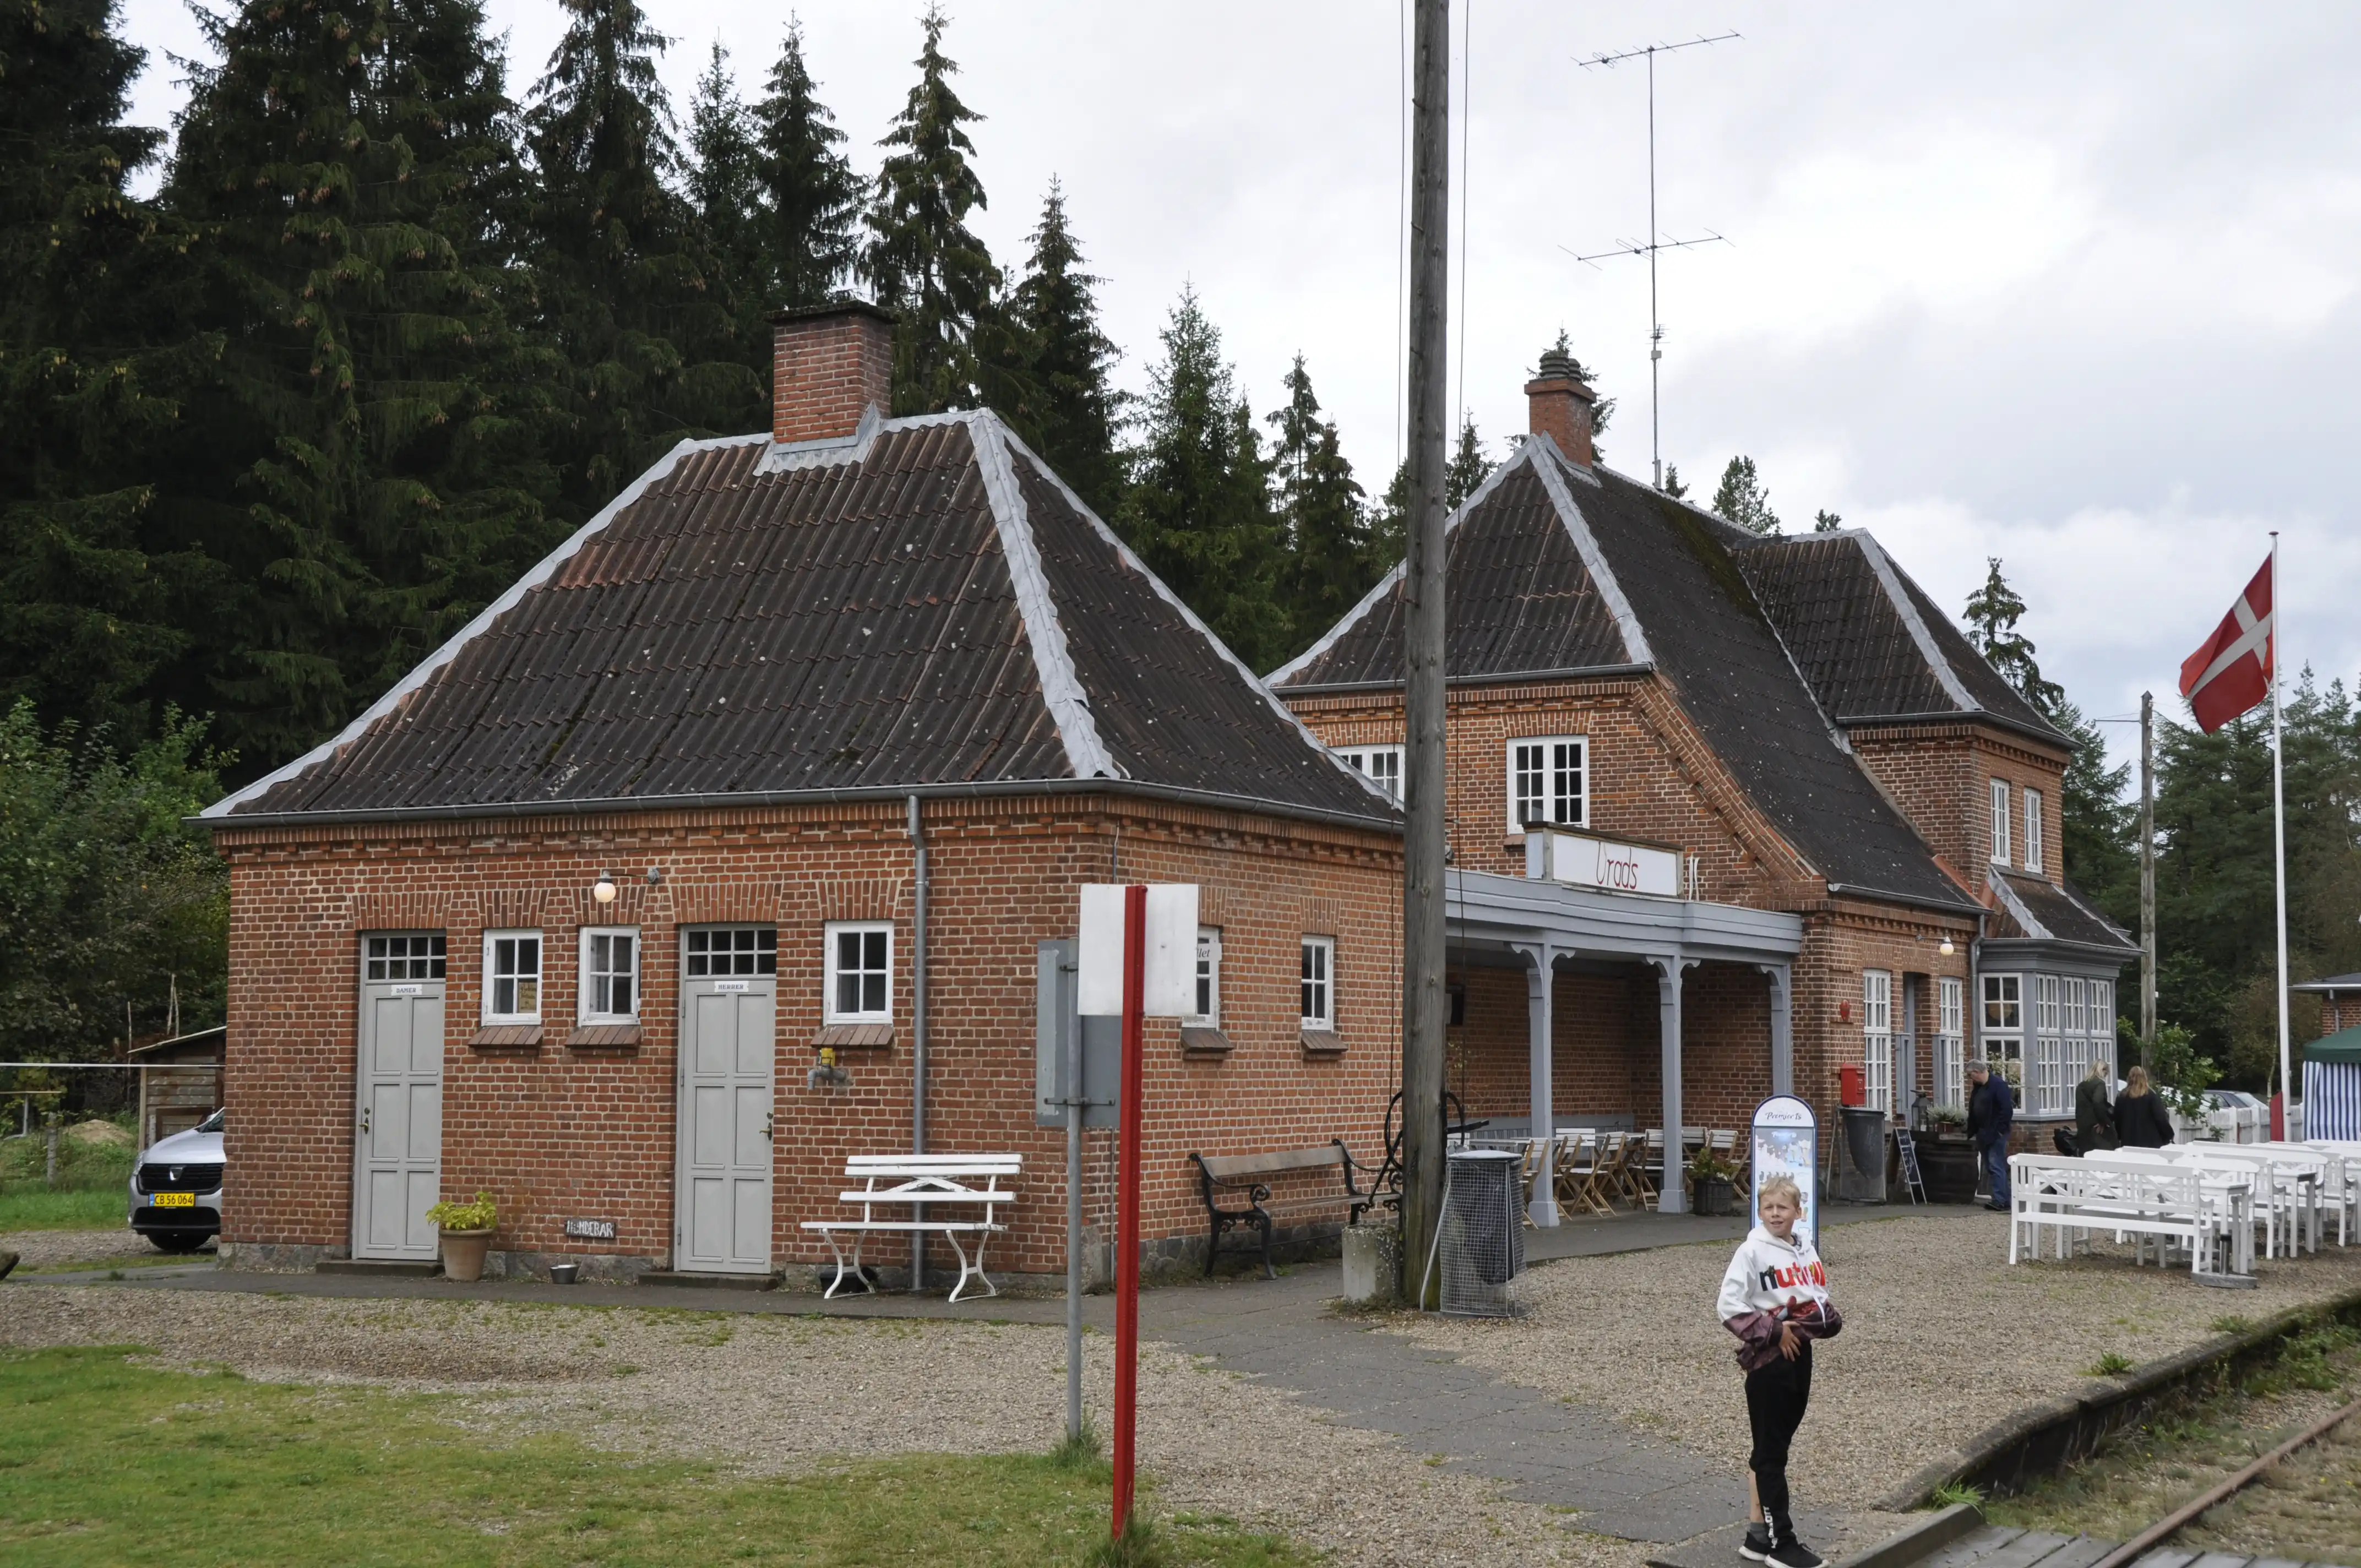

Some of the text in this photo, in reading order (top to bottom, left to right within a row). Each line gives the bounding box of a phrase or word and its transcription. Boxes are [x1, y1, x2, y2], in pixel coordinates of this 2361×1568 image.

[155, 1195, 193, 1205] CB 56 064
